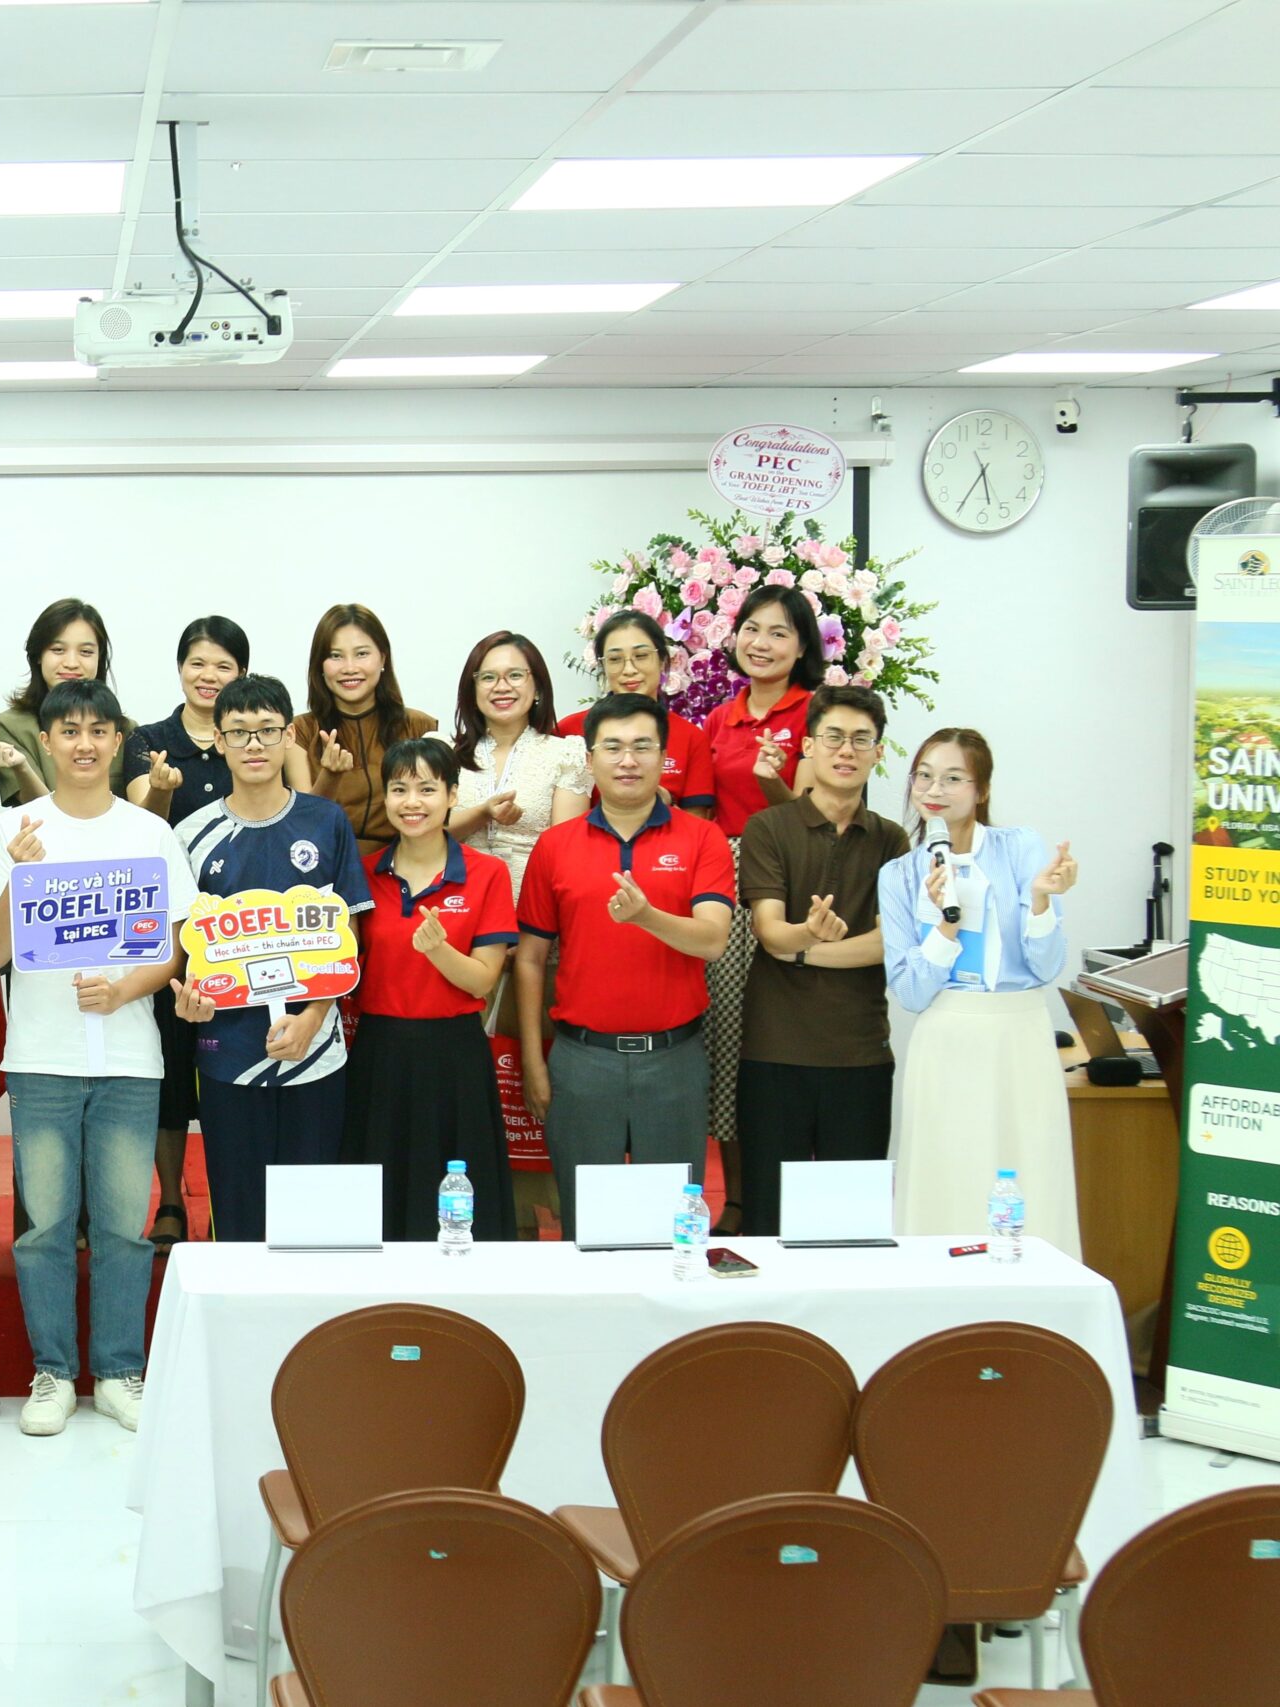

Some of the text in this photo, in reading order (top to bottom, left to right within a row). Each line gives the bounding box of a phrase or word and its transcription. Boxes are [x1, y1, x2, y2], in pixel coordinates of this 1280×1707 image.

[976, 418, 993, 436] 12
[733, 433, 830, 455] Congratulations
[940, 442, 957, 459] 10
[1016, 440, 1029, 458] 2
[756, 454, 802, 472] PEC
[931, 462, 944, 479] 9
[1023, 463, 1035, 480] 3
[729, 471, 823, 489] GRAND OPENING
[741, 481, 775, 493] TOEFL
[777, 485, 798, 495] iBT
[939, 486, 950, 503] 8
[1015, 486, 1026, 502] 4
[785, 498, 811, 510] ETS
[999, 502, 1010, 519] 5
[976, 508, 988, 524] 6
[45, 868, 132, 896] Học và thi
[1204, 867, 1280, 885] STUDY IN
[1204, 885, 1280, 904] BUILD YO
[21, 886, 159, 924] TOEFL iBT
[63, 924, 109, 943] tại PEC
[137, 922, 154, 930] PEC
[194, 905, 341, 944] TOEFL iBT
[214, 947, 230, 959] Học
[232, 943, 251, 955] chất
[262, 940, 275, 950] thi
[276, 937, 300, 949] chuẩn
[302, 936, 315, 947] tại
[316, 935, 334, 945] PEC
[207, 977, 229, 989] PEC
[1201, 1095, 1280, 1117] AFFORDAB
[503, 1114, 529, 1126] OEIC,
[1201, 1111, 1262, 1132] TUITION
[523, 1131, 542, 1140] YLE
[1207, 1192, 1280, 1216] REASONS
[1203, 1272, 1252, 1288] GLOBALLY
[1196, 1281, 1258, 1300] RECOGNIZED
[1208, 1293, 1245, 1309] DEGREE
